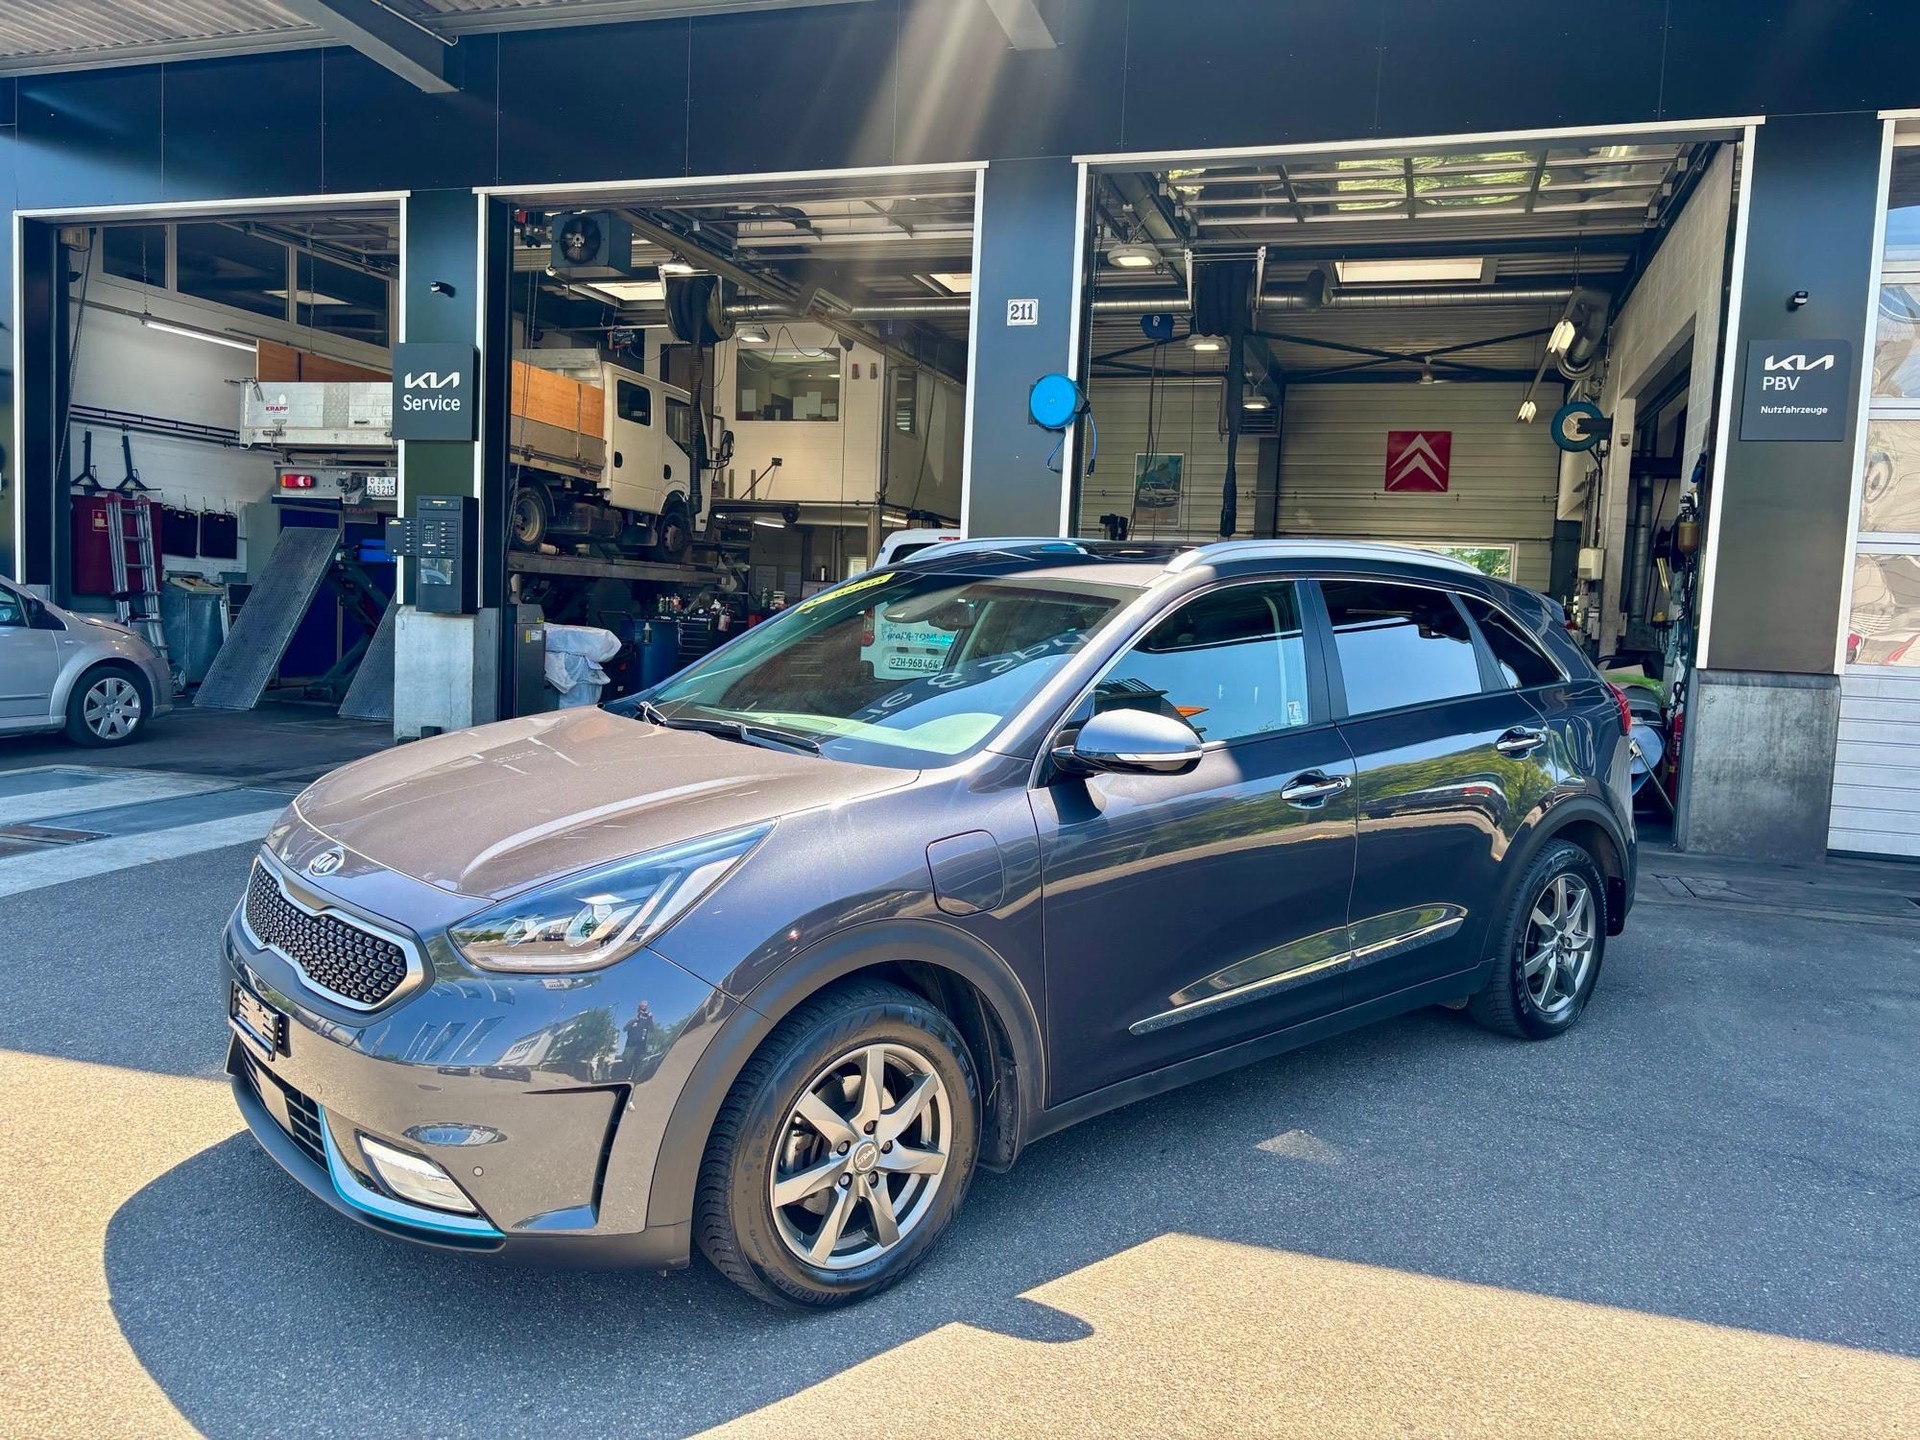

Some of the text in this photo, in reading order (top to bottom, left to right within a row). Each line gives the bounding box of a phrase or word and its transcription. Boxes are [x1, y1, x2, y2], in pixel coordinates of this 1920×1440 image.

[1010, 303, 1034, 320] 211
[1764, 354, 1834, 371] KIA
[404, 372, 460, 389] KIA
[1762, 376, 1800, 391] PBV
[402, 394, 461, 411] Service
[1760, 405, 1828, 416] Nutzfahrzeuge
[367, 485, 395, 496] 943215
